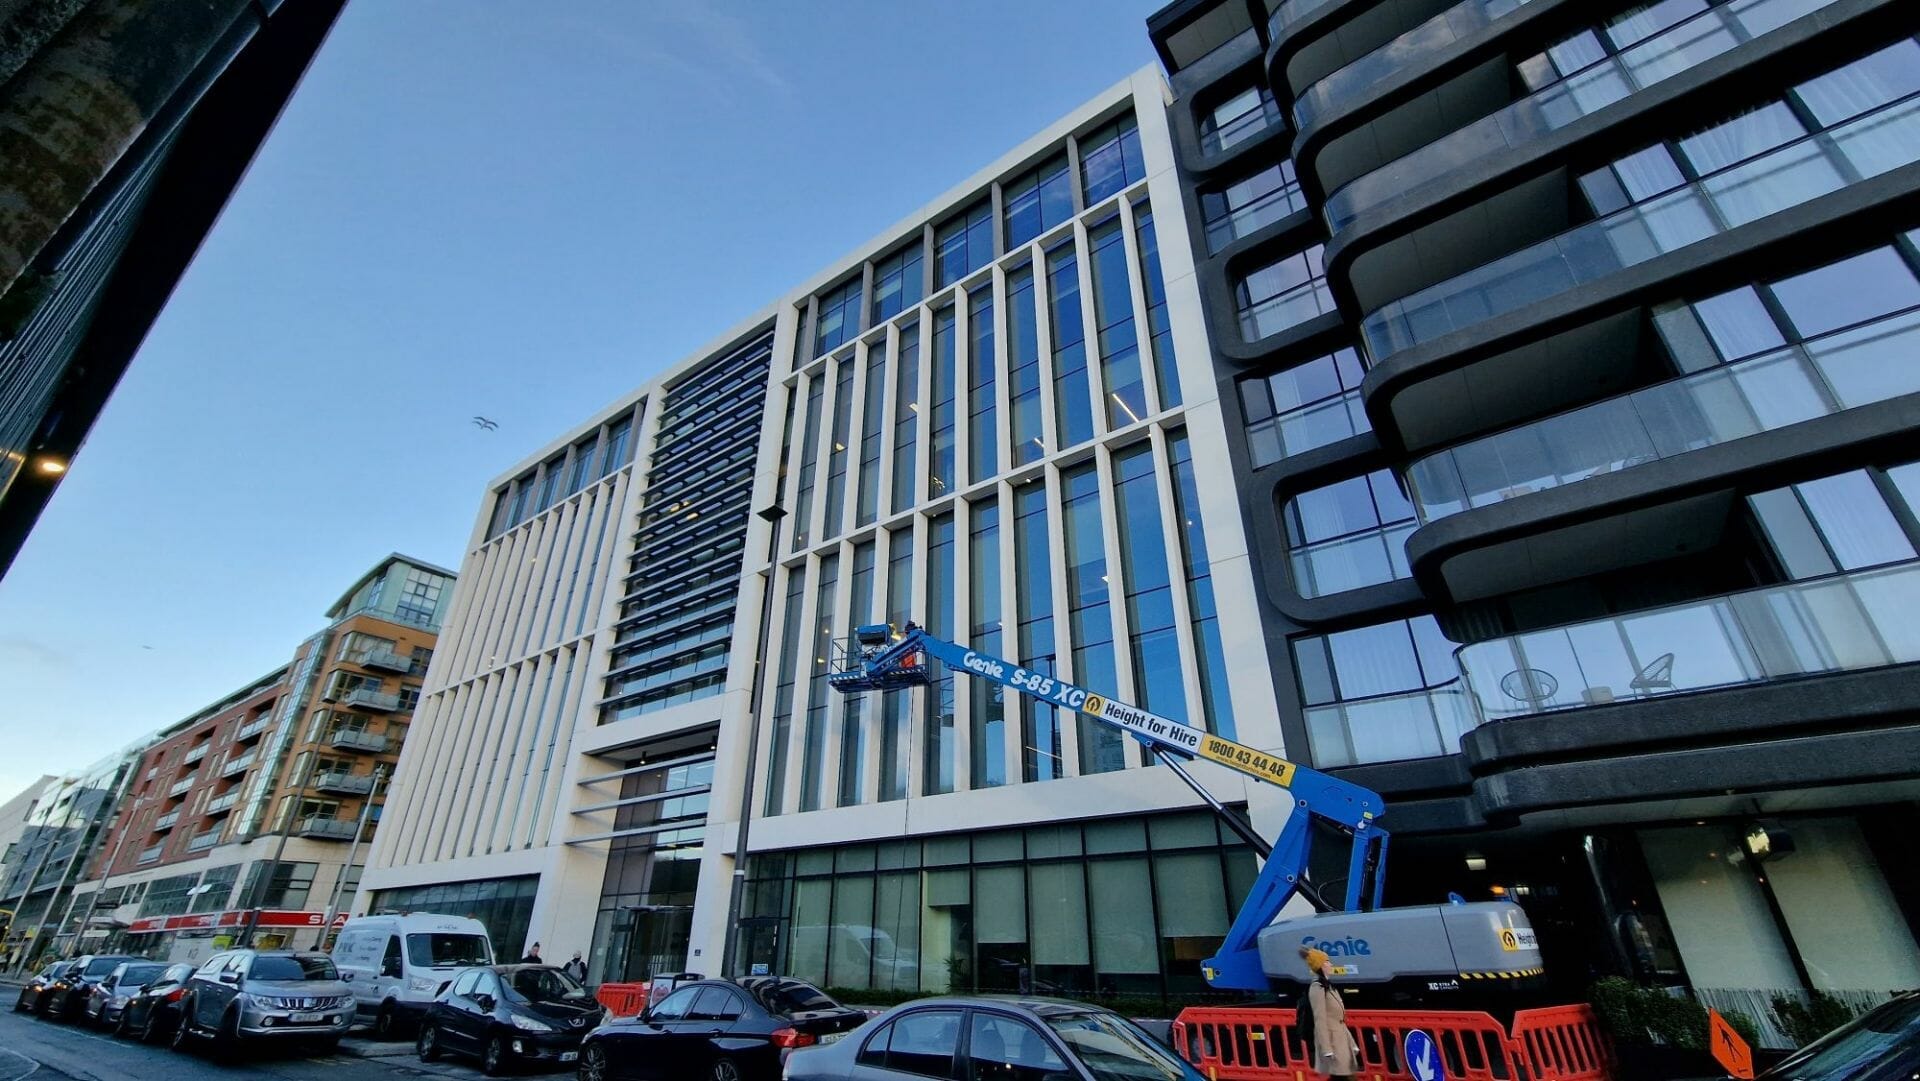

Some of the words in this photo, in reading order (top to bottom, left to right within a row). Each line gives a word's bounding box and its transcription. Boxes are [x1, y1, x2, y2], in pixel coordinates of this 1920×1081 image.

[963, 651, 1003, 679] Genie
[1011, 669, 1054, 695] S-85
[1053, 684, 1085, 706] XC
[1105, 703, 1145, 728] Height
[1147, 717, 1168, 735] for
[1169, 726, 1198, 747] Hire
[1208, 740, 1235, 758] 1800
[1235, 750, 1252, 765] 43
[1252, 756, 1268, 771] 44
[1269, 762, 1286, 778] 48
